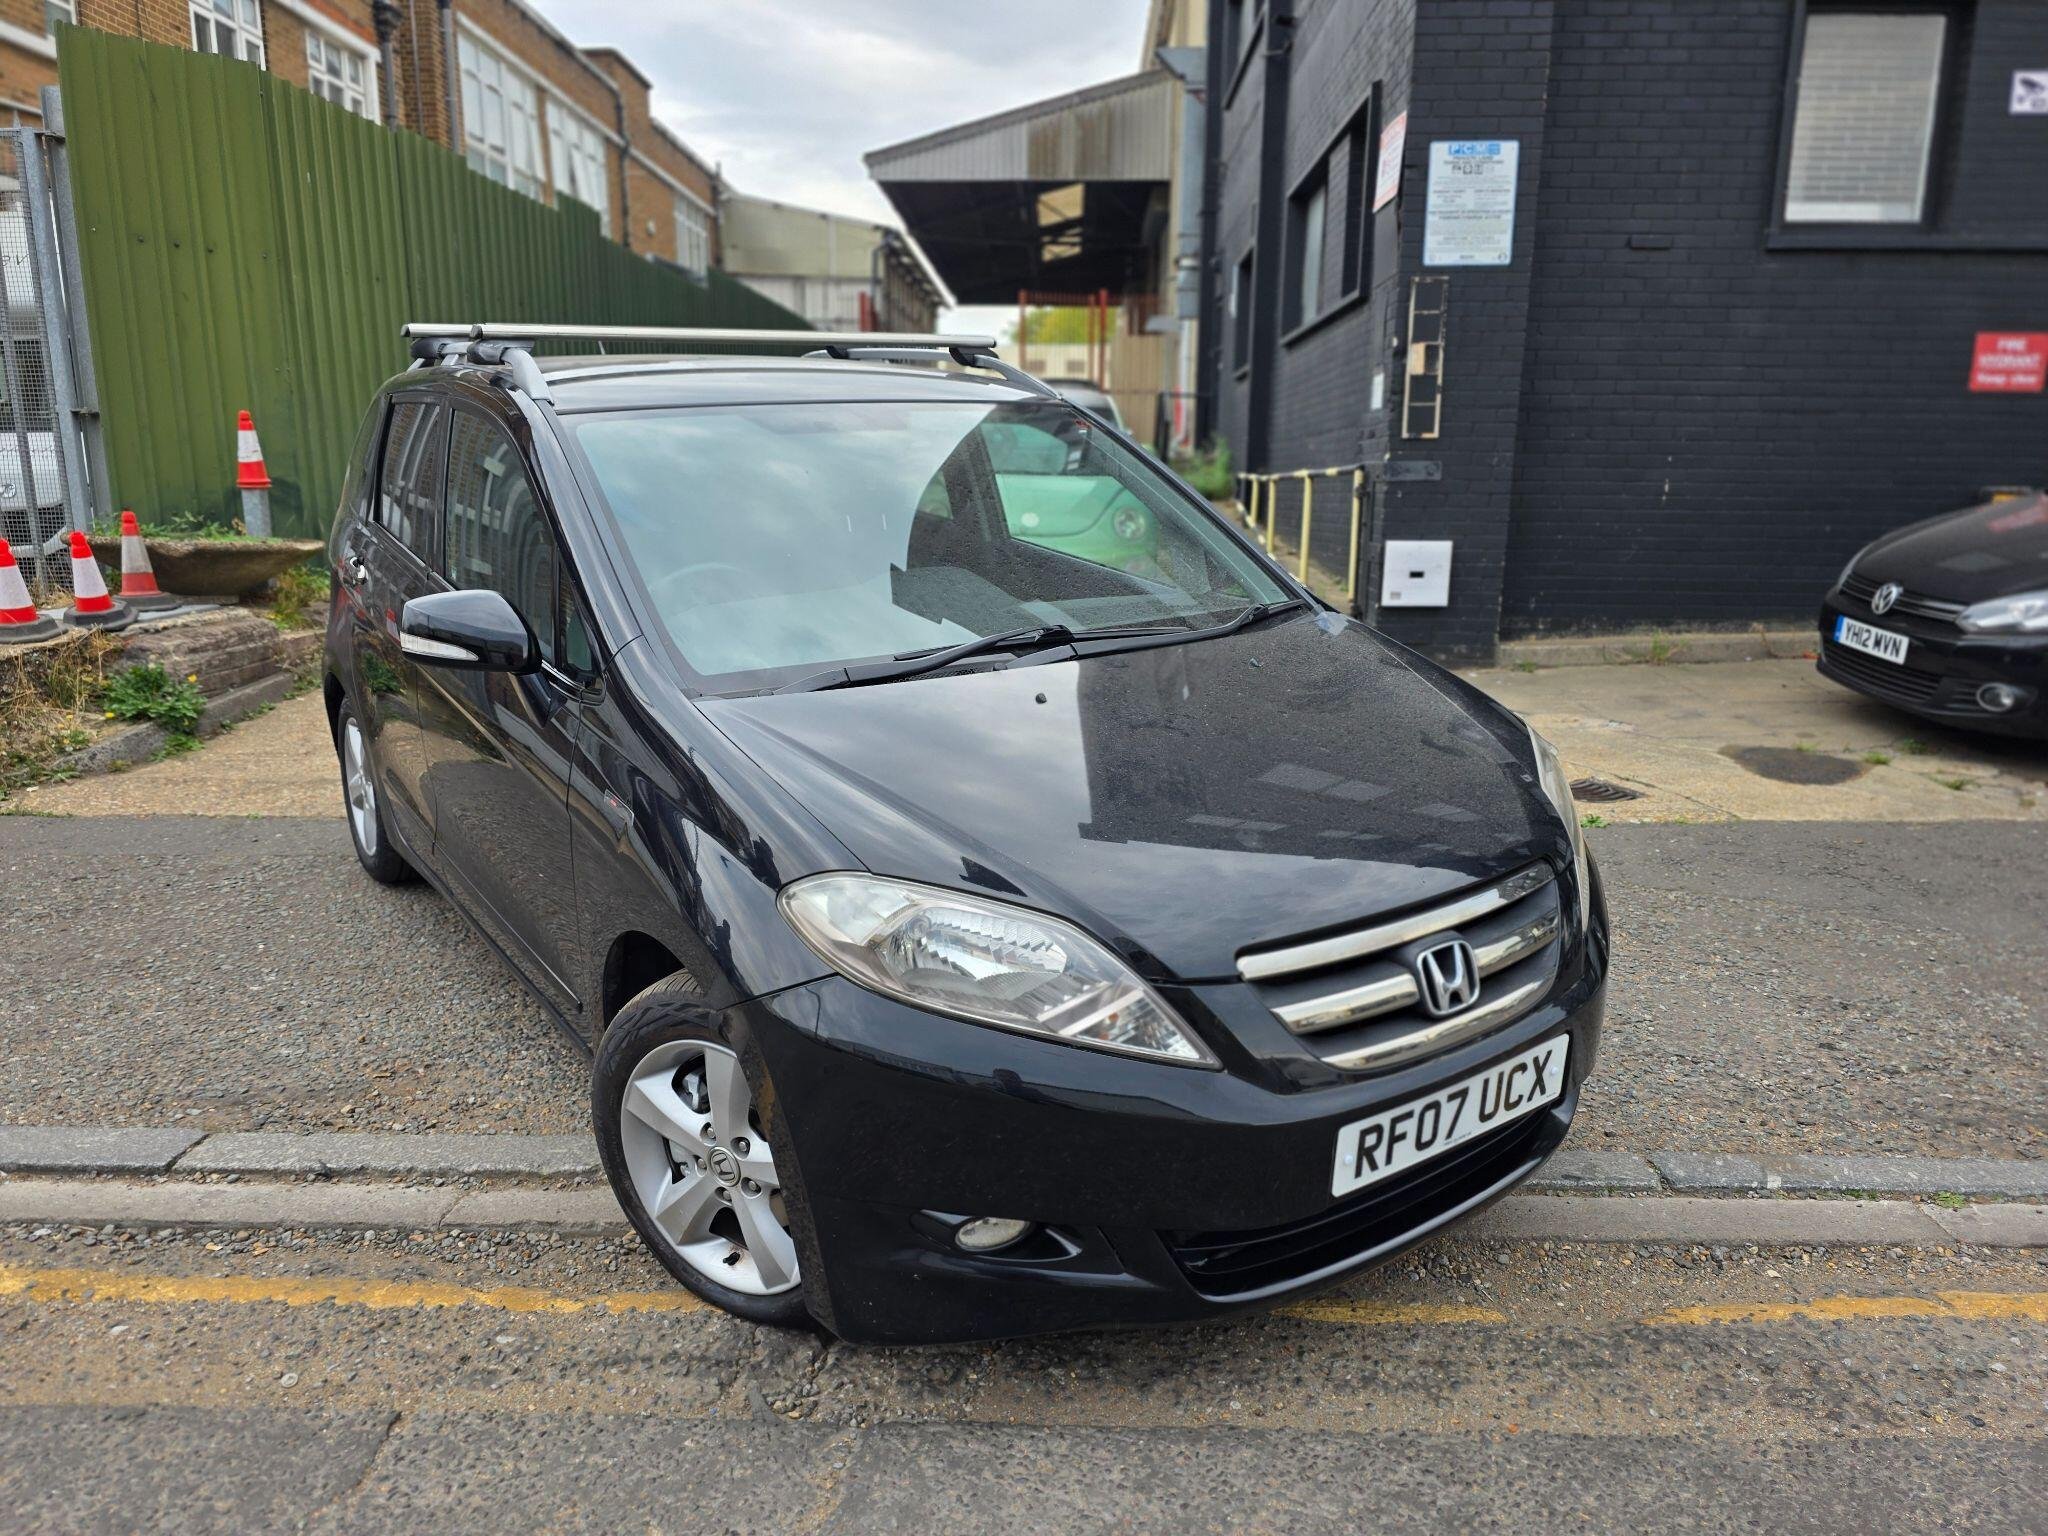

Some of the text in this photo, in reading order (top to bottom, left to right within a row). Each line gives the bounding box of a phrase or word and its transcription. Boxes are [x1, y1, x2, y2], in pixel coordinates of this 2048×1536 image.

[1872, 631, 1902, 658] MVN
[1355, 1050, 1553, 1178] RF07 UCX
